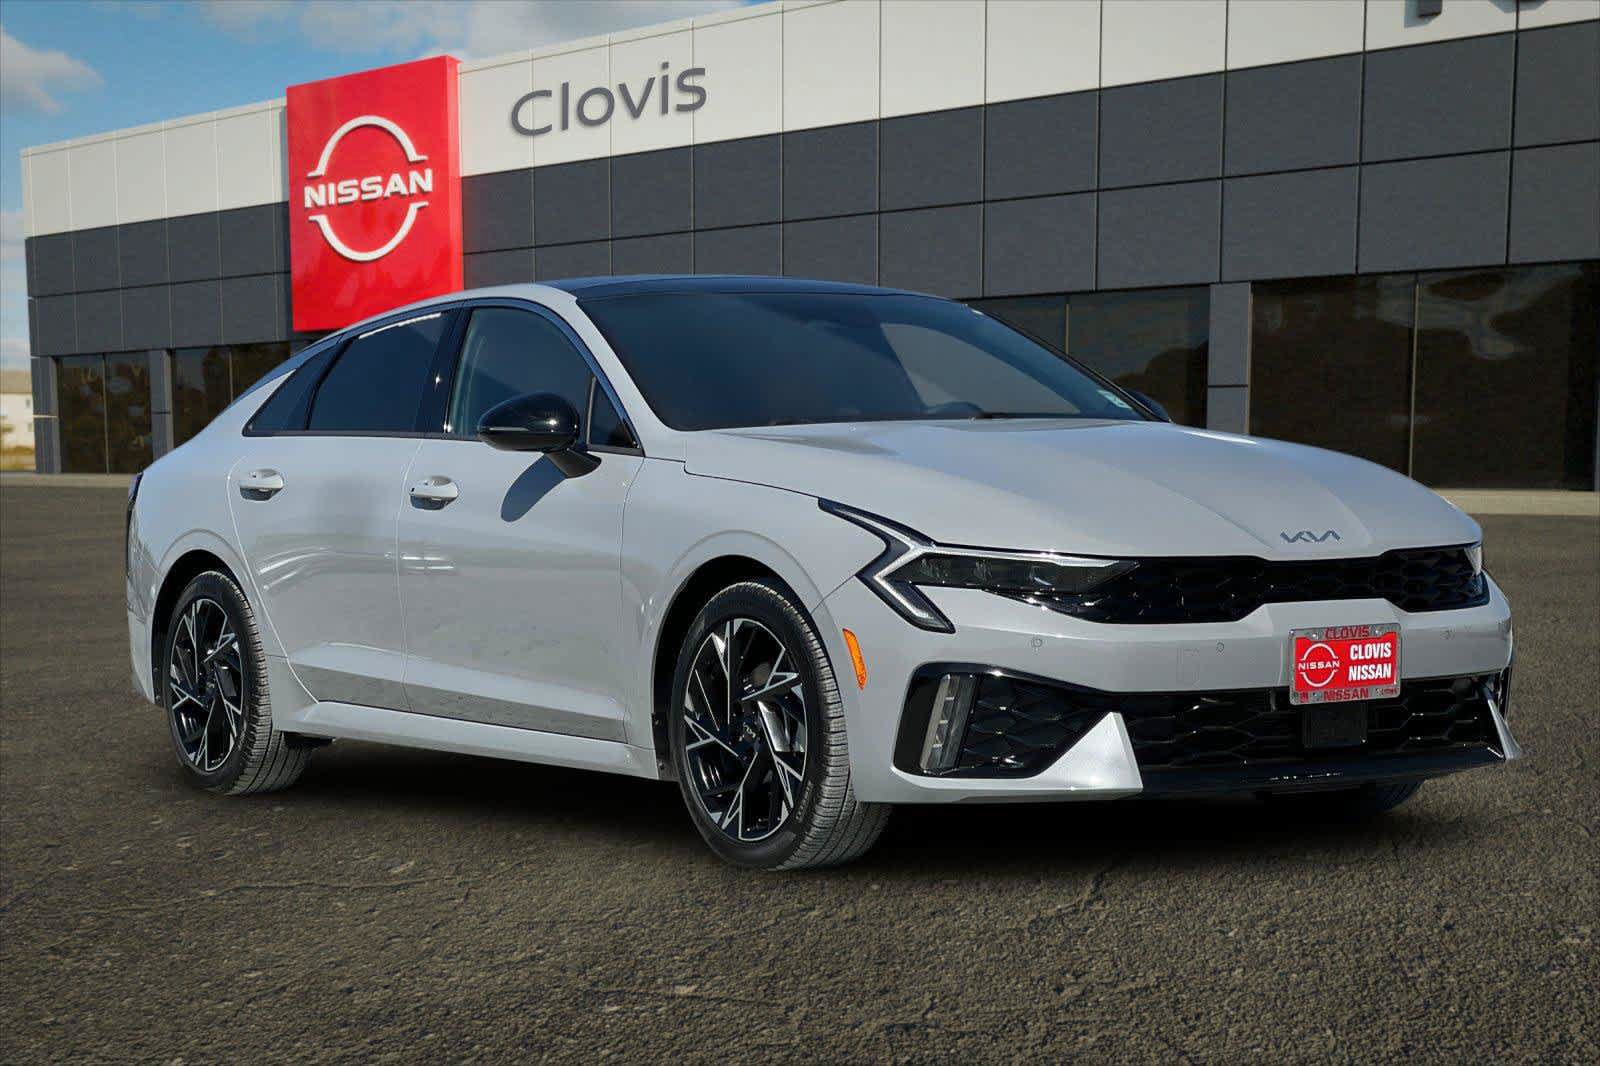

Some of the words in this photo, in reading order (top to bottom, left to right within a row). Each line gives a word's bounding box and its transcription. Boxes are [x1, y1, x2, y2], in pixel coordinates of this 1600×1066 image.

[511, 62, 707, 137] Clovis
[304, 168, 433, 209] NISSAN
[1325, 626, 1370, 640] CLOVIS
[1350, 642, 1392, 660] CLOVIS
[1298, 660, 1340, 671] NISSAN
[1348, 663, 1392, 681] NISSAN
[1324, 688, 1369, 701] NISSAN
